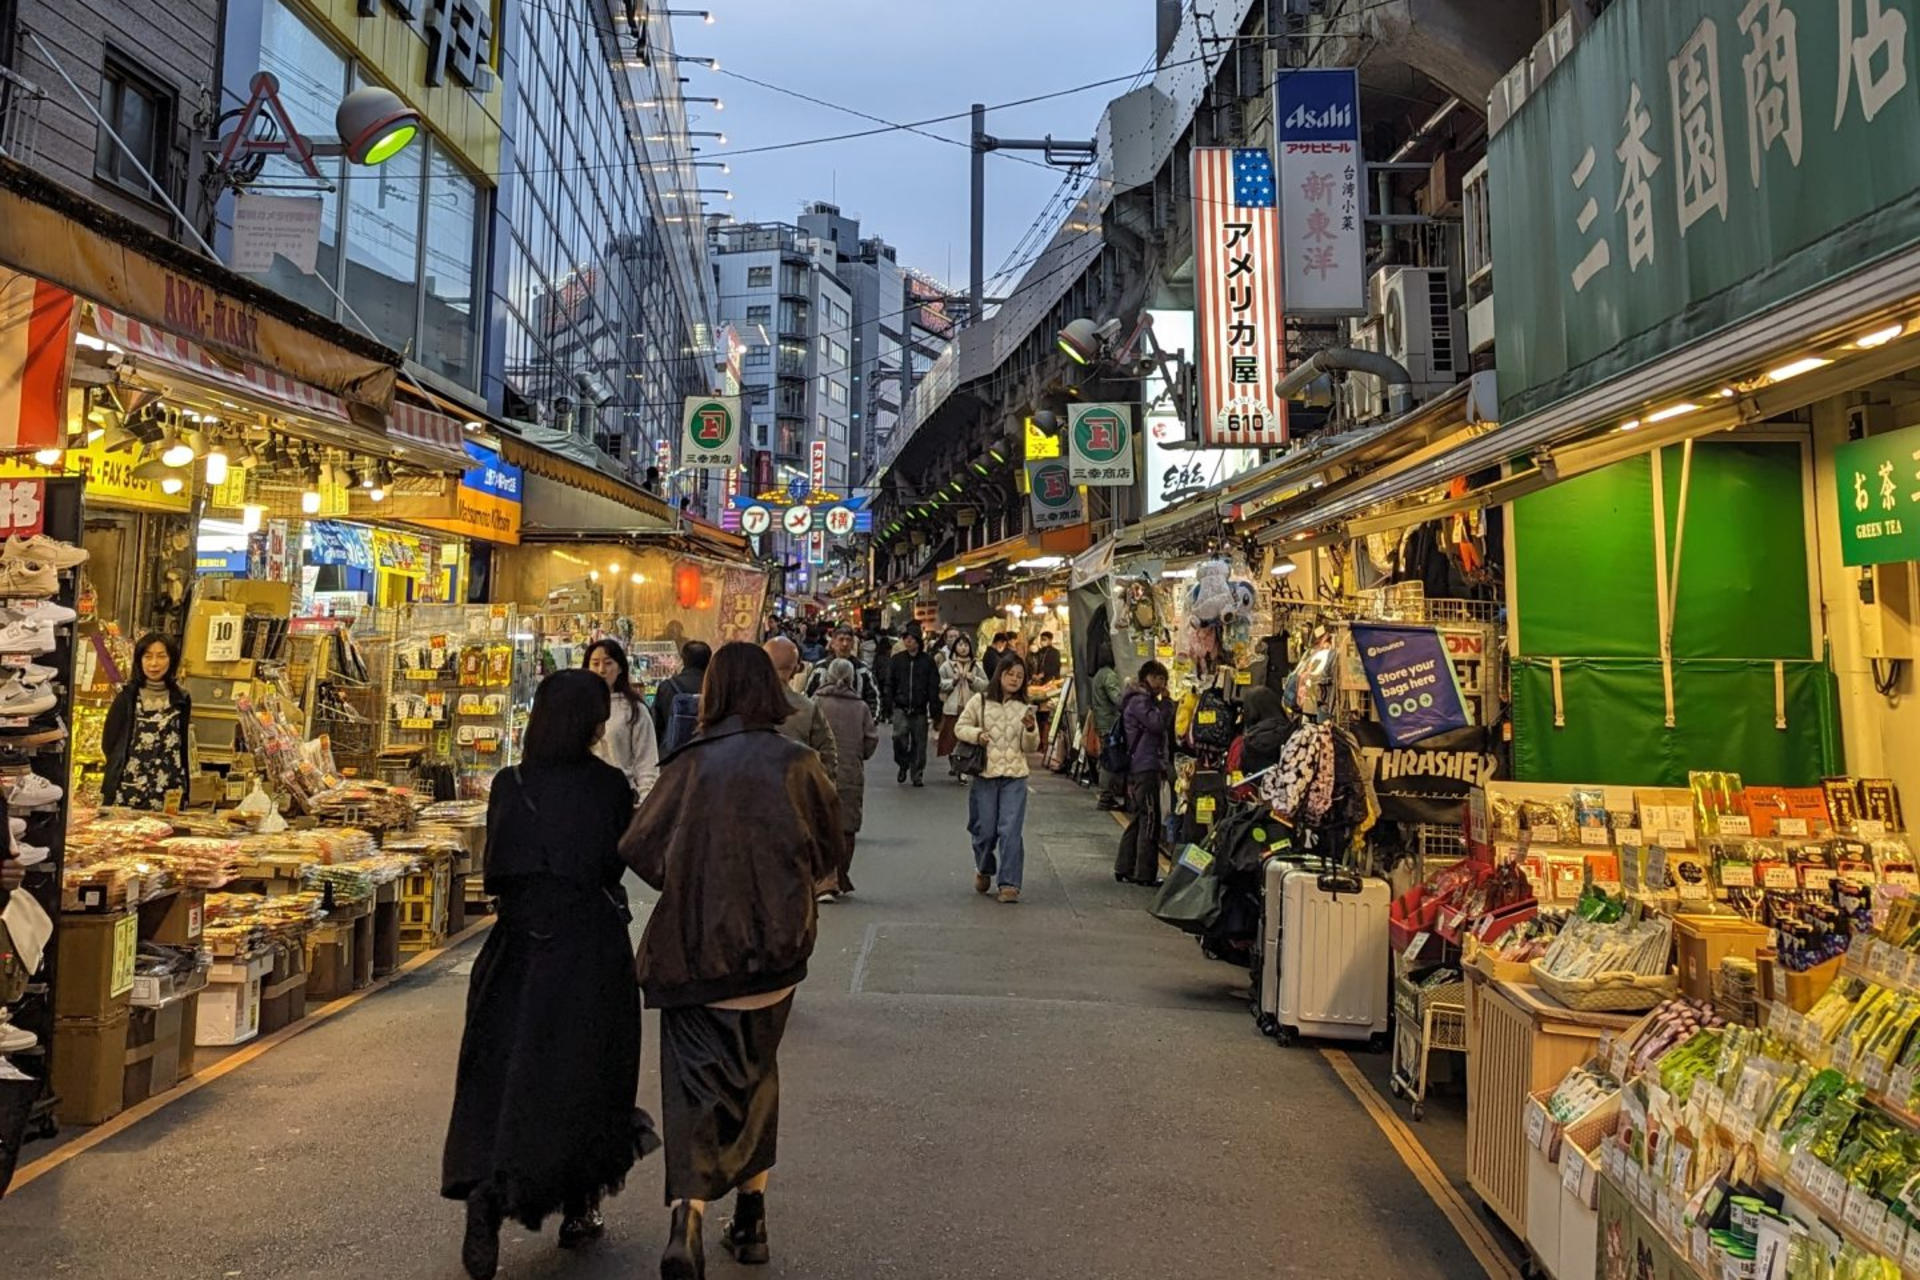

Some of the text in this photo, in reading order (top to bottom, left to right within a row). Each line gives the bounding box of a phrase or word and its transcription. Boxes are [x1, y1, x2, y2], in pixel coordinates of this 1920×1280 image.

[1285, 103, 1352, 129] Asahi
[1286, 143, 1351, 154] アサヒビール
[1301, 170, 1339, 282] 新東洋
[1223, 222, 1260, 385] アメリカ屋
[1228, 414, 1264, 432] 610
[747, 511, 850, 529] アメ横
[1855, 520, 1903, 539] GREEN TEA
[215, 621, 233, 641] 10
[1377, 659, 1436, 685] Store your
[1381, 674, 1436, 698] bags here
